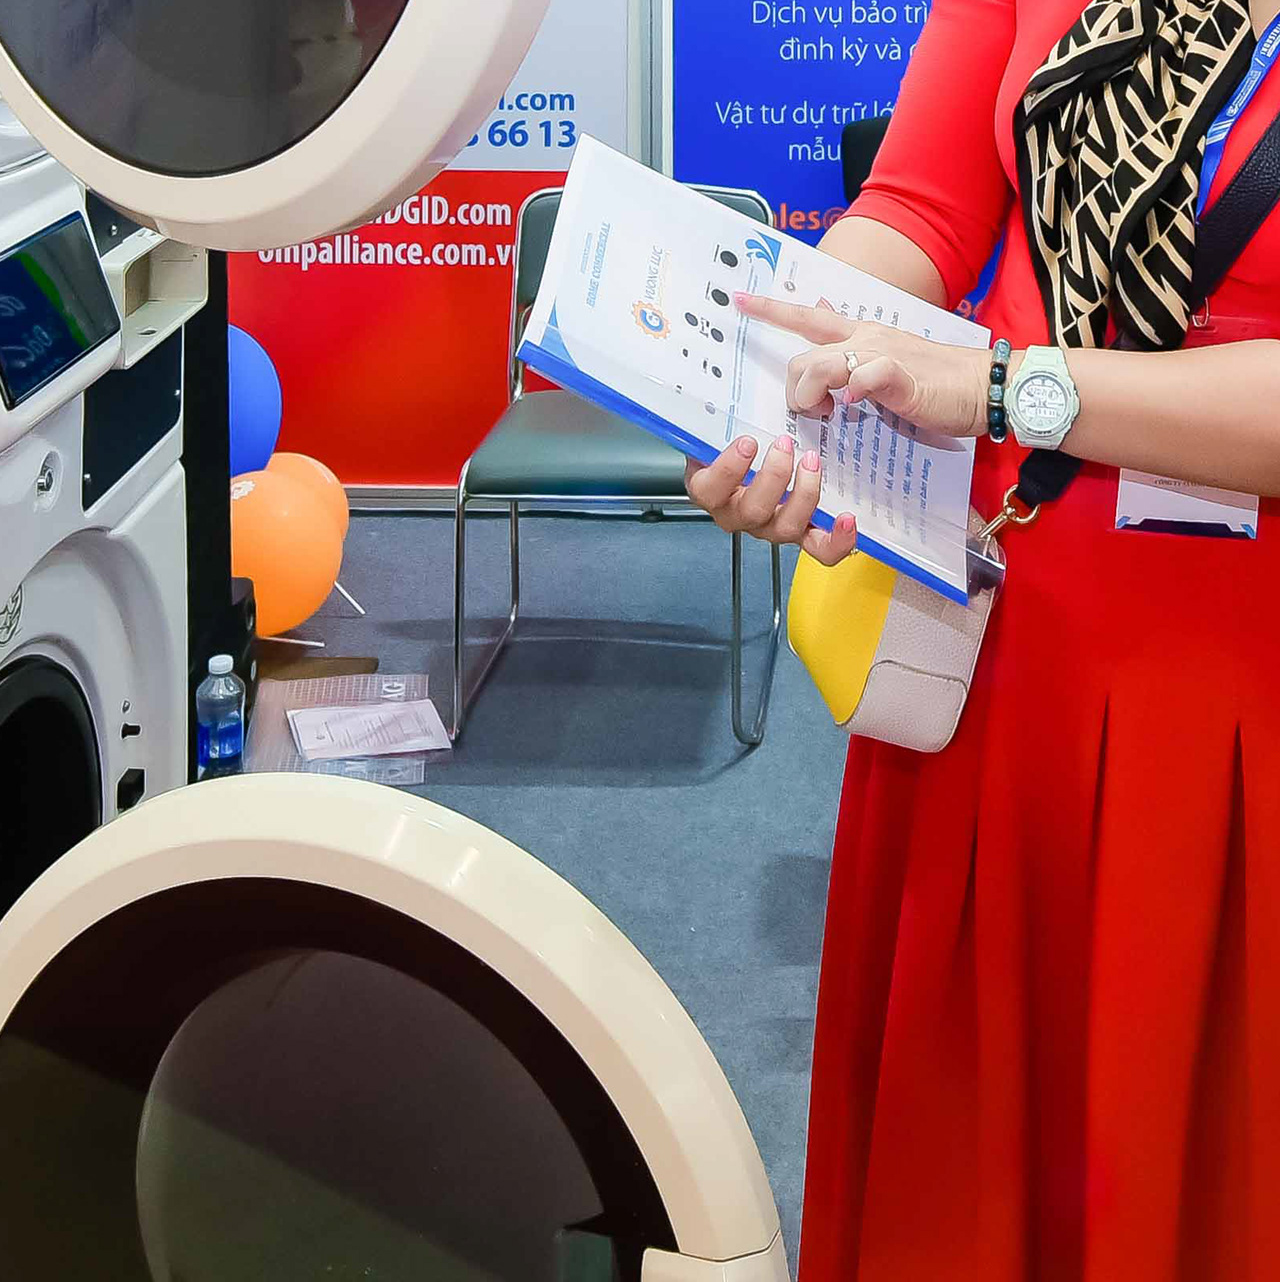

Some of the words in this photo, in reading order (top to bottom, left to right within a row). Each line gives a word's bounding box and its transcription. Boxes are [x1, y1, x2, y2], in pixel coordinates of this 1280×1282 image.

[752, 0, 807, 28] Dịch
[814, 5, 844, 29] vụ
[851, 0, 898, 26] bảo
[779, 36, 835, 62] đình
[874, 37, 902, 62] và
[715, 99, 757, 127] Vật
[759, 101, 786, 126] tư
[792, 100, 825, 128] dự
[486, 120, 530, 148] 66
[538, 120, 578, 148] 13
[788, 136, 841, 162] mẫu
[369, 195, 512, 225] DGID.com
